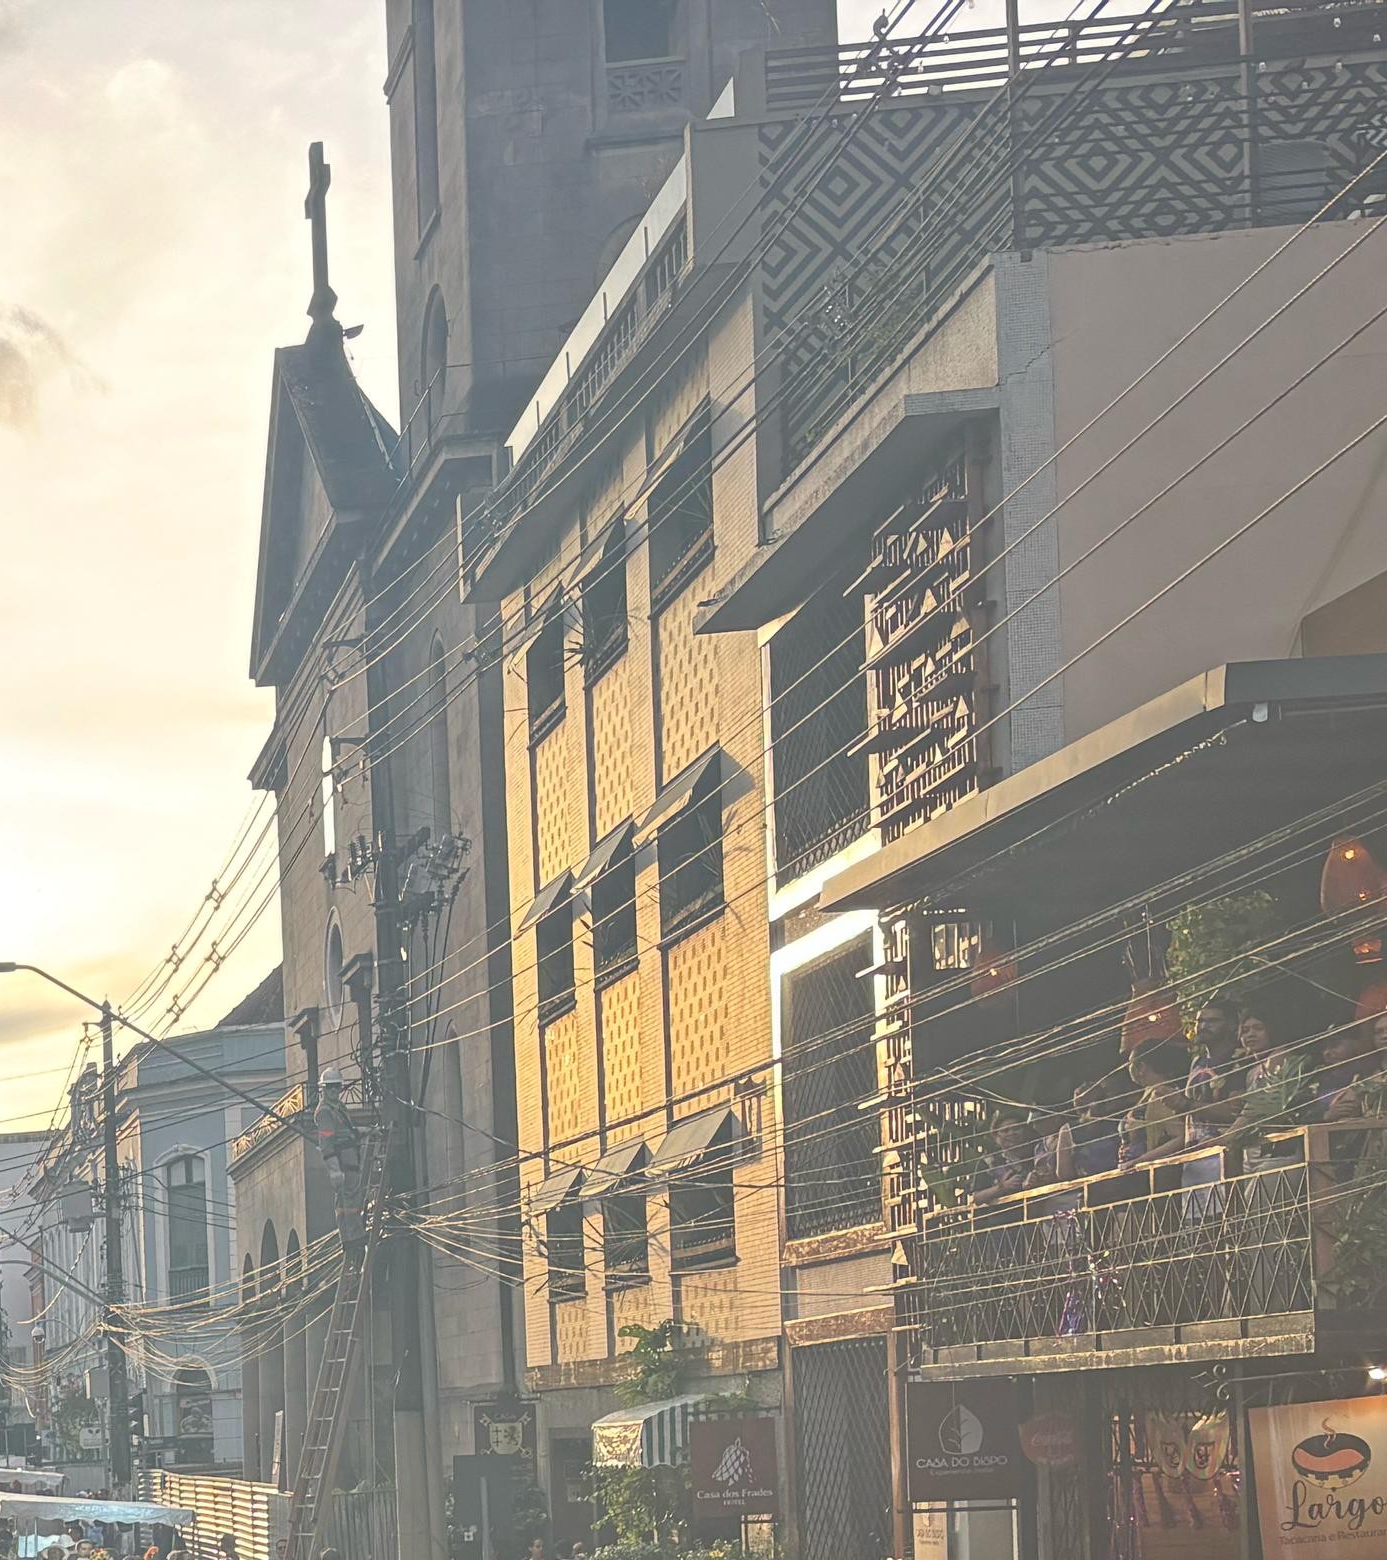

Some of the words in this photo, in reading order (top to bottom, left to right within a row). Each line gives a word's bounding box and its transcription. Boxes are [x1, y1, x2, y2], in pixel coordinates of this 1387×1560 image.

[915, 1457, 949, 1469] CASA
[951, 1456, 970, 1467] DO
[696, 1490, 721, 1499] Casa
[722, 1488, 740, 1498] dos
[741, 1487, 774, 1498] Frades
[1279, 1480, 1387, 1531] Largo
